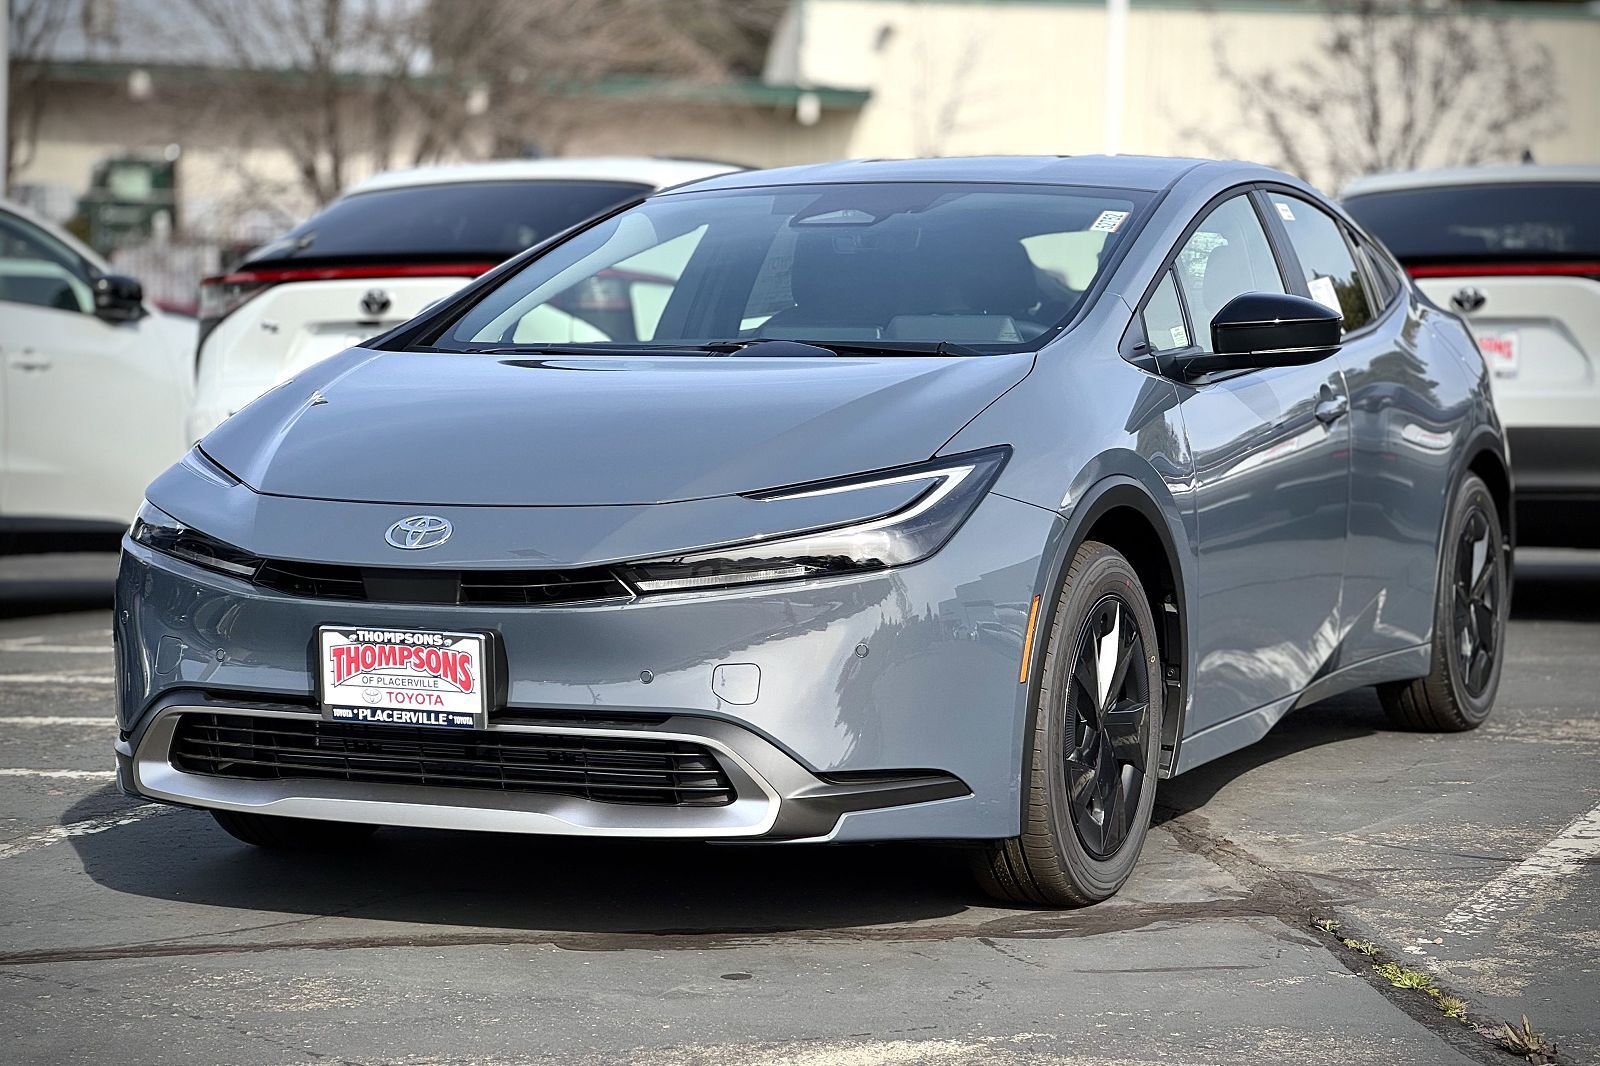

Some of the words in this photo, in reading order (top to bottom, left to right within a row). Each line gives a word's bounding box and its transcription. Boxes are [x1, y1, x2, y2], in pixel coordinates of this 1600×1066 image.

[356, 631, 443, 646] THOMPSONS
[333, 645, 472, 692] THOMPSONS
[362, 676, 374, 684] OF
[377, 676, 439, 689] PLACERVILLE
[386, 691, 444, 706] TOYOTA
[358, 709, 448, 725] PLACERVILLE
[453, 716, 474, 726] TOYOTA
